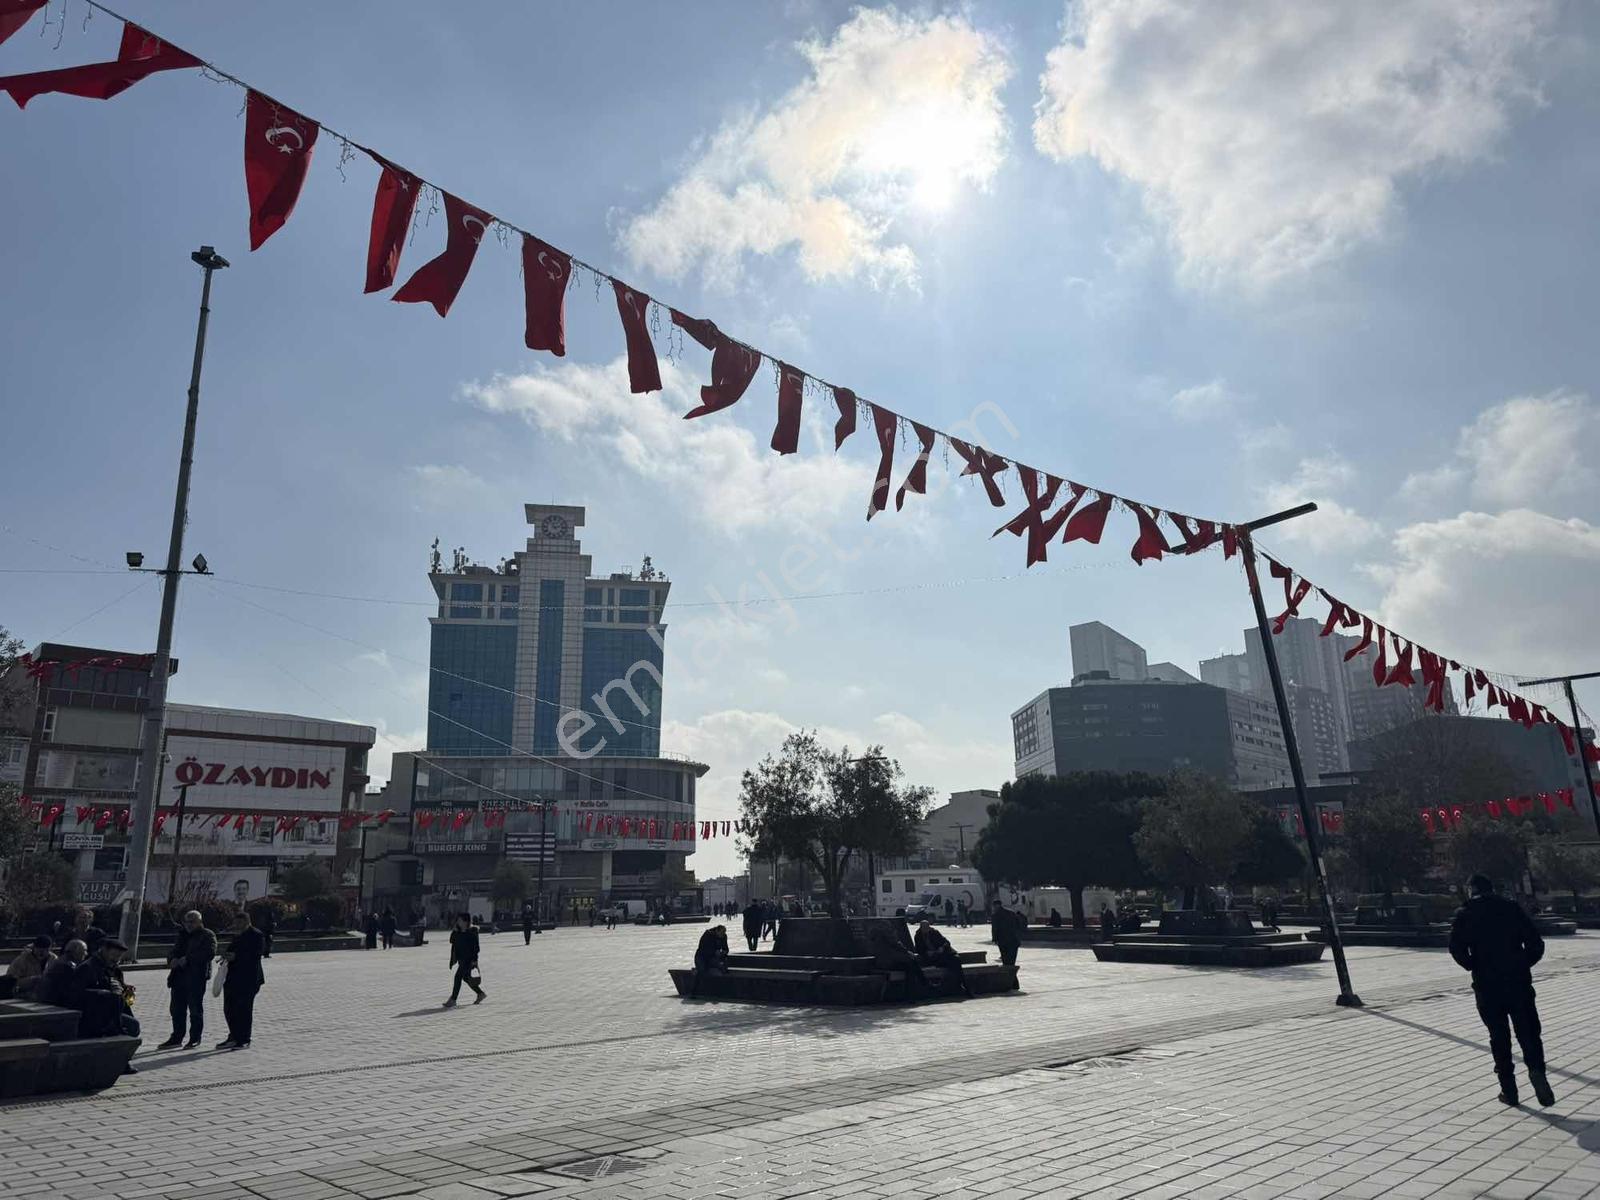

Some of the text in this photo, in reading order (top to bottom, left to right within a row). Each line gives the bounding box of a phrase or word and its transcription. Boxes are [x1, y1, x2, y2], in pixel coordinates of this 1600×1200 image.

[174, 756, 331, 790] ÖZAYDIN
[427, 843, 487, 852] BURGER KING
[80, 882, 121, 892] YURT
